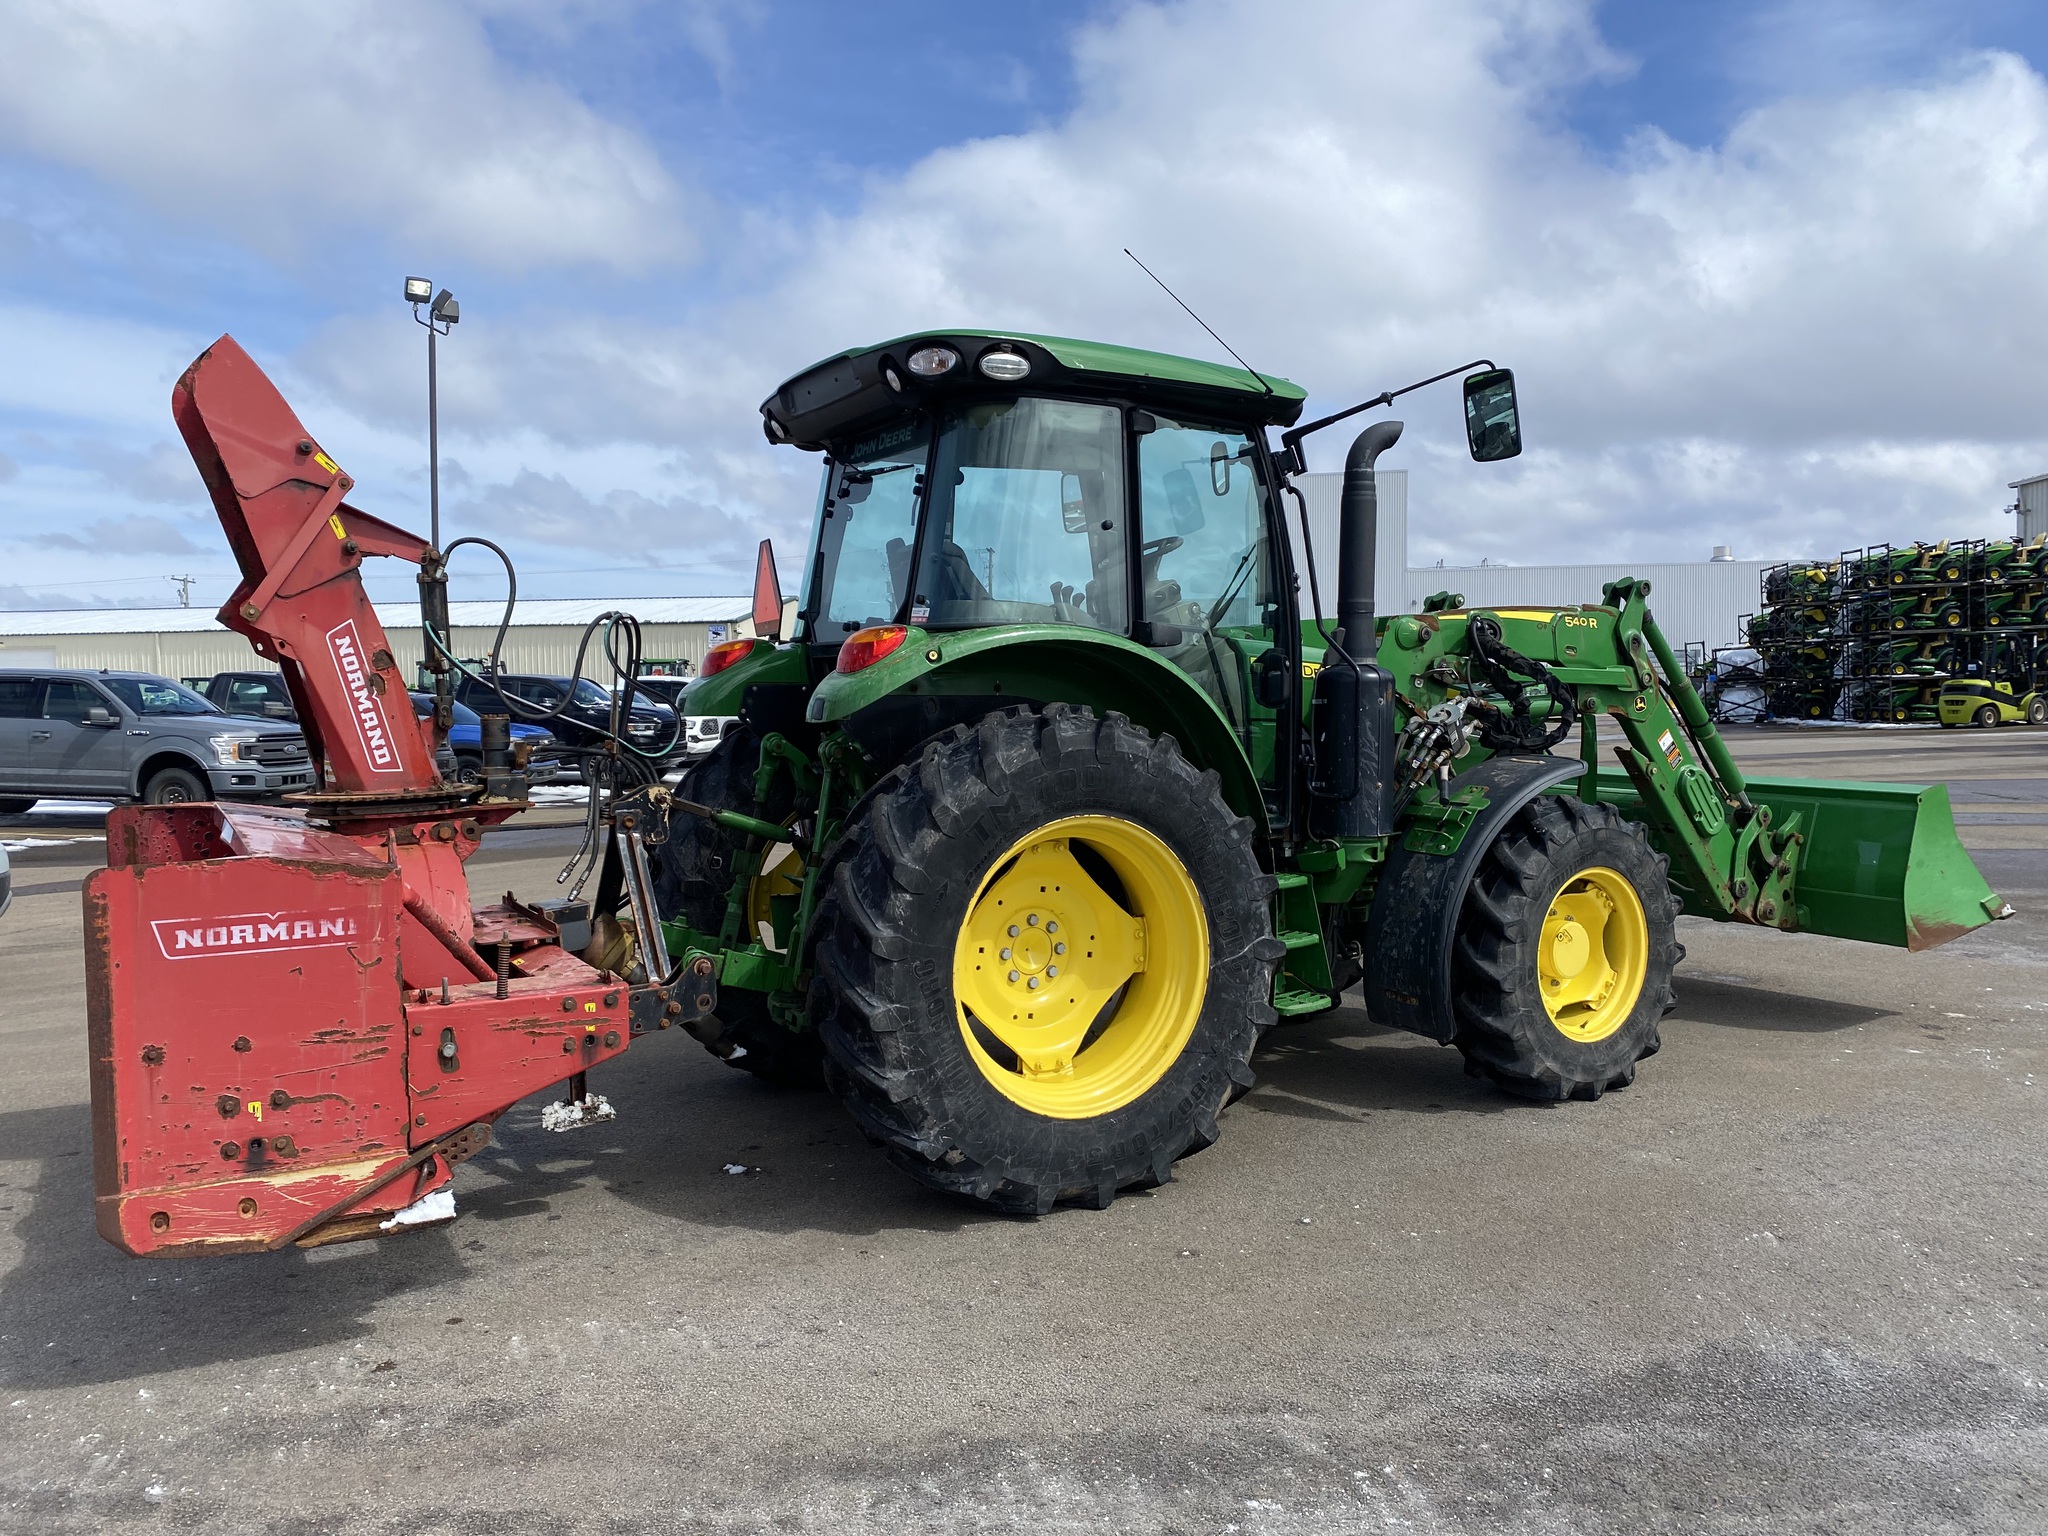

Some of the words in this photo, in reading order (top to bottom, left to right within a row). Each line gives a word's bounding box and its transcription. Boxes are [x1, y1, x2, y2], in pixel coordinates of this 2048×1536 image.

[850, 438, 877, 460] JOHN
[878, 426, 914, 450] DEERE
[335, 635, 391, 765] NORMAND
